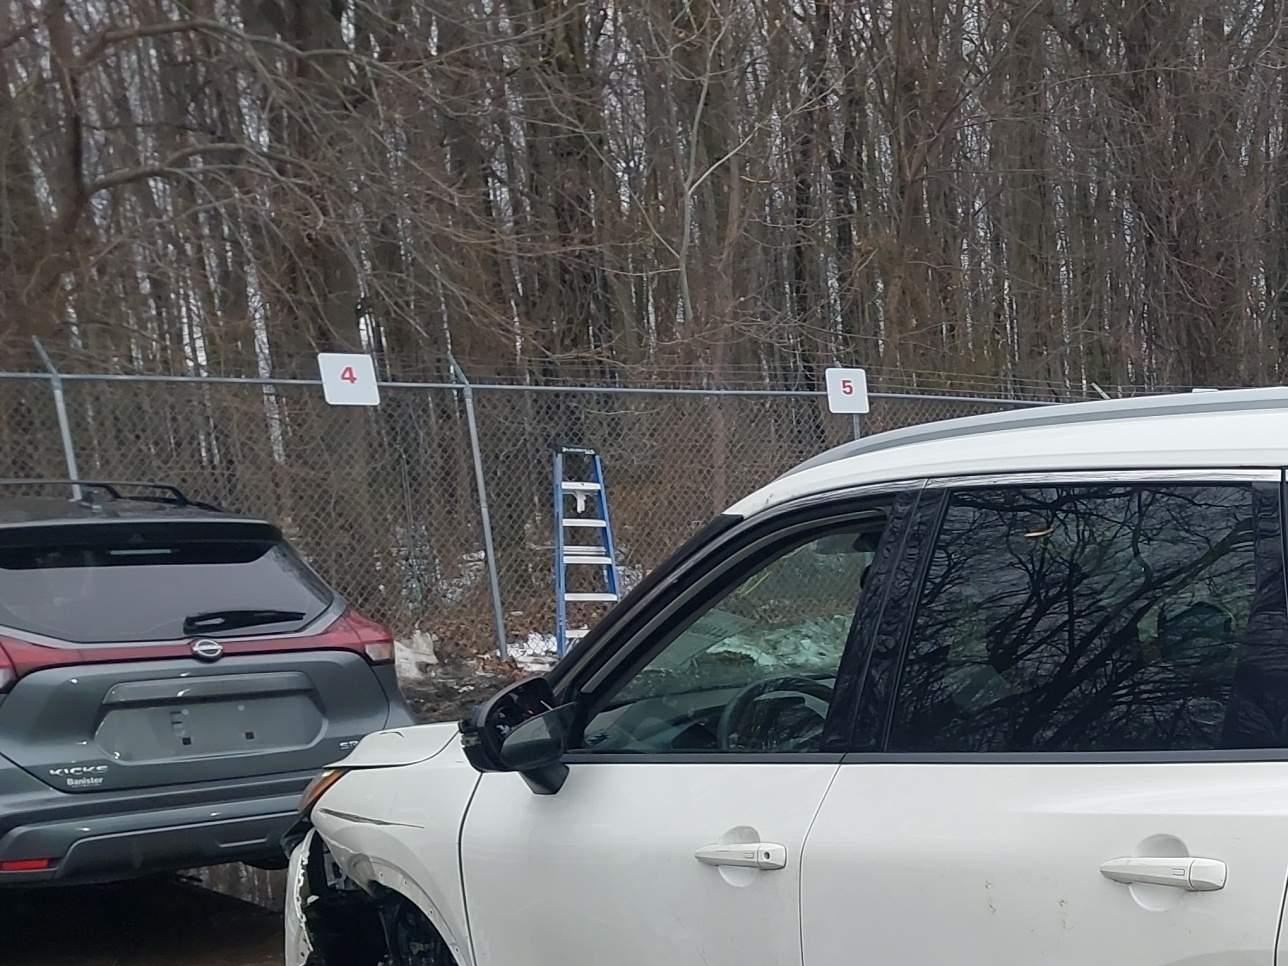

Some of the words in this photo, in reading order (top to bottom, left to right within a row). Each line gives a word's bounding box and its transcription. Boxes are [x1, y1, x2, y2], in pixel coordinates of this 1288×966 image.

[341, 366, 358, 384] 4
[841, 379, 854, 395] 5
[49, 765, 108, 776] KICKS
[66, 777, 104, 785] Banister
